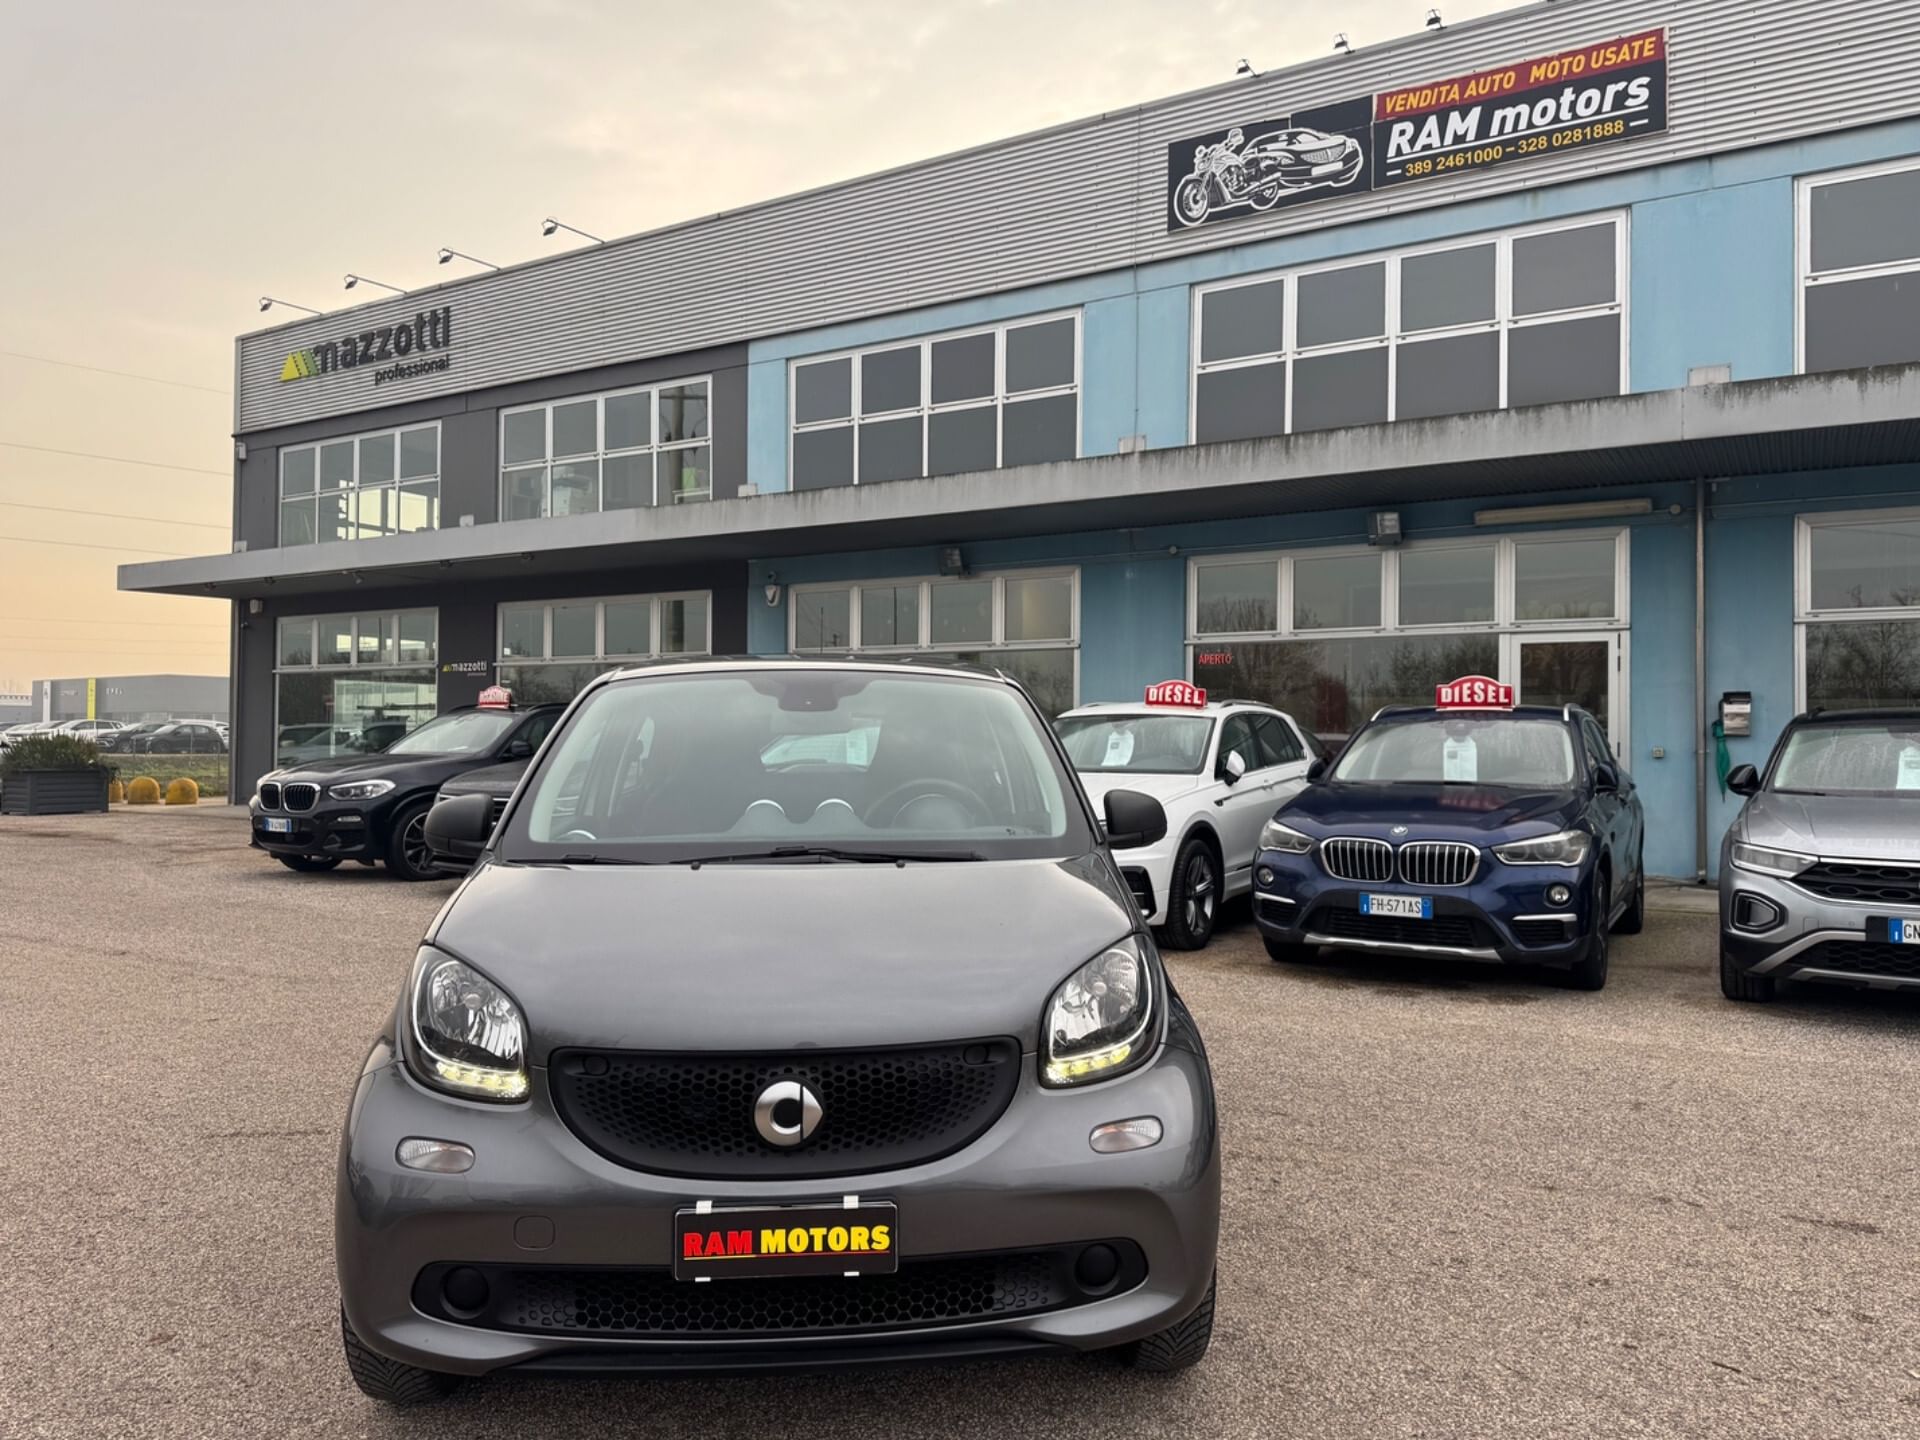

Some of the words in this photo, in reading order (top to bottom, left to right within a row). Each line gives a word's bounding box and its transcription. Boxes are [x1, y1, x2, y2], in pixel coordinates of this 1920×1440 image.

[1385, 83, 1460, 113] VENDITA
[1463, 71, 1516, 98] AUTO
[1529, 54, 1586, 83] MOTO
[1590, 36, 1656, 69] USATE
[1386, 105, 1482, 158] RAM
[1489, 76, 1651, 137] motors
[1405, 159, 1432, 177] 389
[1436, 145, 1503, 171] 2461000
[1517, 135, 1548, 154] 328
[1552, 119, 1624, 147] 0281888
[313, 306, 451, 374] mazzotti
[374, 353, 450, 386] professional
[452, 660, 487, 672] mazzotti
[1199, 653, 1232, 665] APERTO
[1148, 684, 1202, 705] DIESEL
[1440, 681, 1509, 704] DIESEL
[683, 1229, 753, 1257] RAM
[760, 1225, 890, 1254] MOTORS
